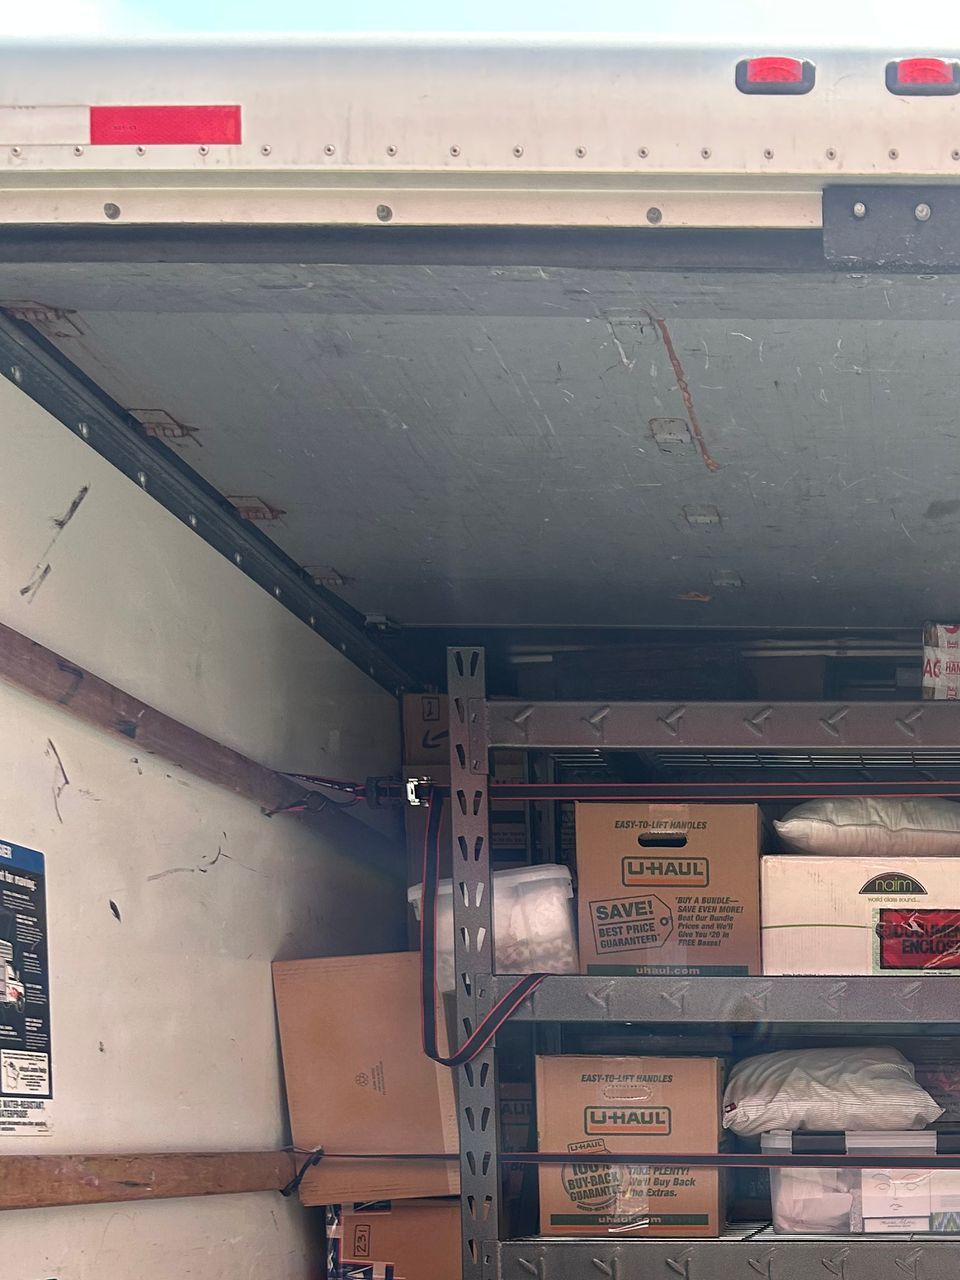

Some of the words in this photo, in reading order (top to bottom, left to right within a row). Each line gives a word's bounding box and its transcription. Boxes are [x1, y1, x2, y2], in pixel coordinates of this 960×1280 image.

[615, 820, 668, 829] EASY-TO-LIFT
[670, 821, 707, 829] HANDLES
[628, 862, 703, 875] U-HAUL
[876, 878, 912, 891] naim
[596, 901, 653, 920] SAVE!
[599, 926, 623, 937] BEST
[626, 923, 655, 934] PRICE
[636, 966, 700, 975] uhaul.com
[581, 1074, 635, 1083] EASY-TO-LIFT
[636, 1074, 672, 1083] HANDLES
[590, 1111, 665, 1124] U-HAUL
[570, 1141, 603, 1152] U-HAUL
[653, 1167, 689, 1176] PLENTY!
[567, 1172, 619, 1190] BUY-BACK
[653, 1178, 671, 1188] Buy
[672, 1178, 696, 1186] Back
[646, 1188, 677, 1197] Extras.
[356, 1229, 367, 1253] 231
